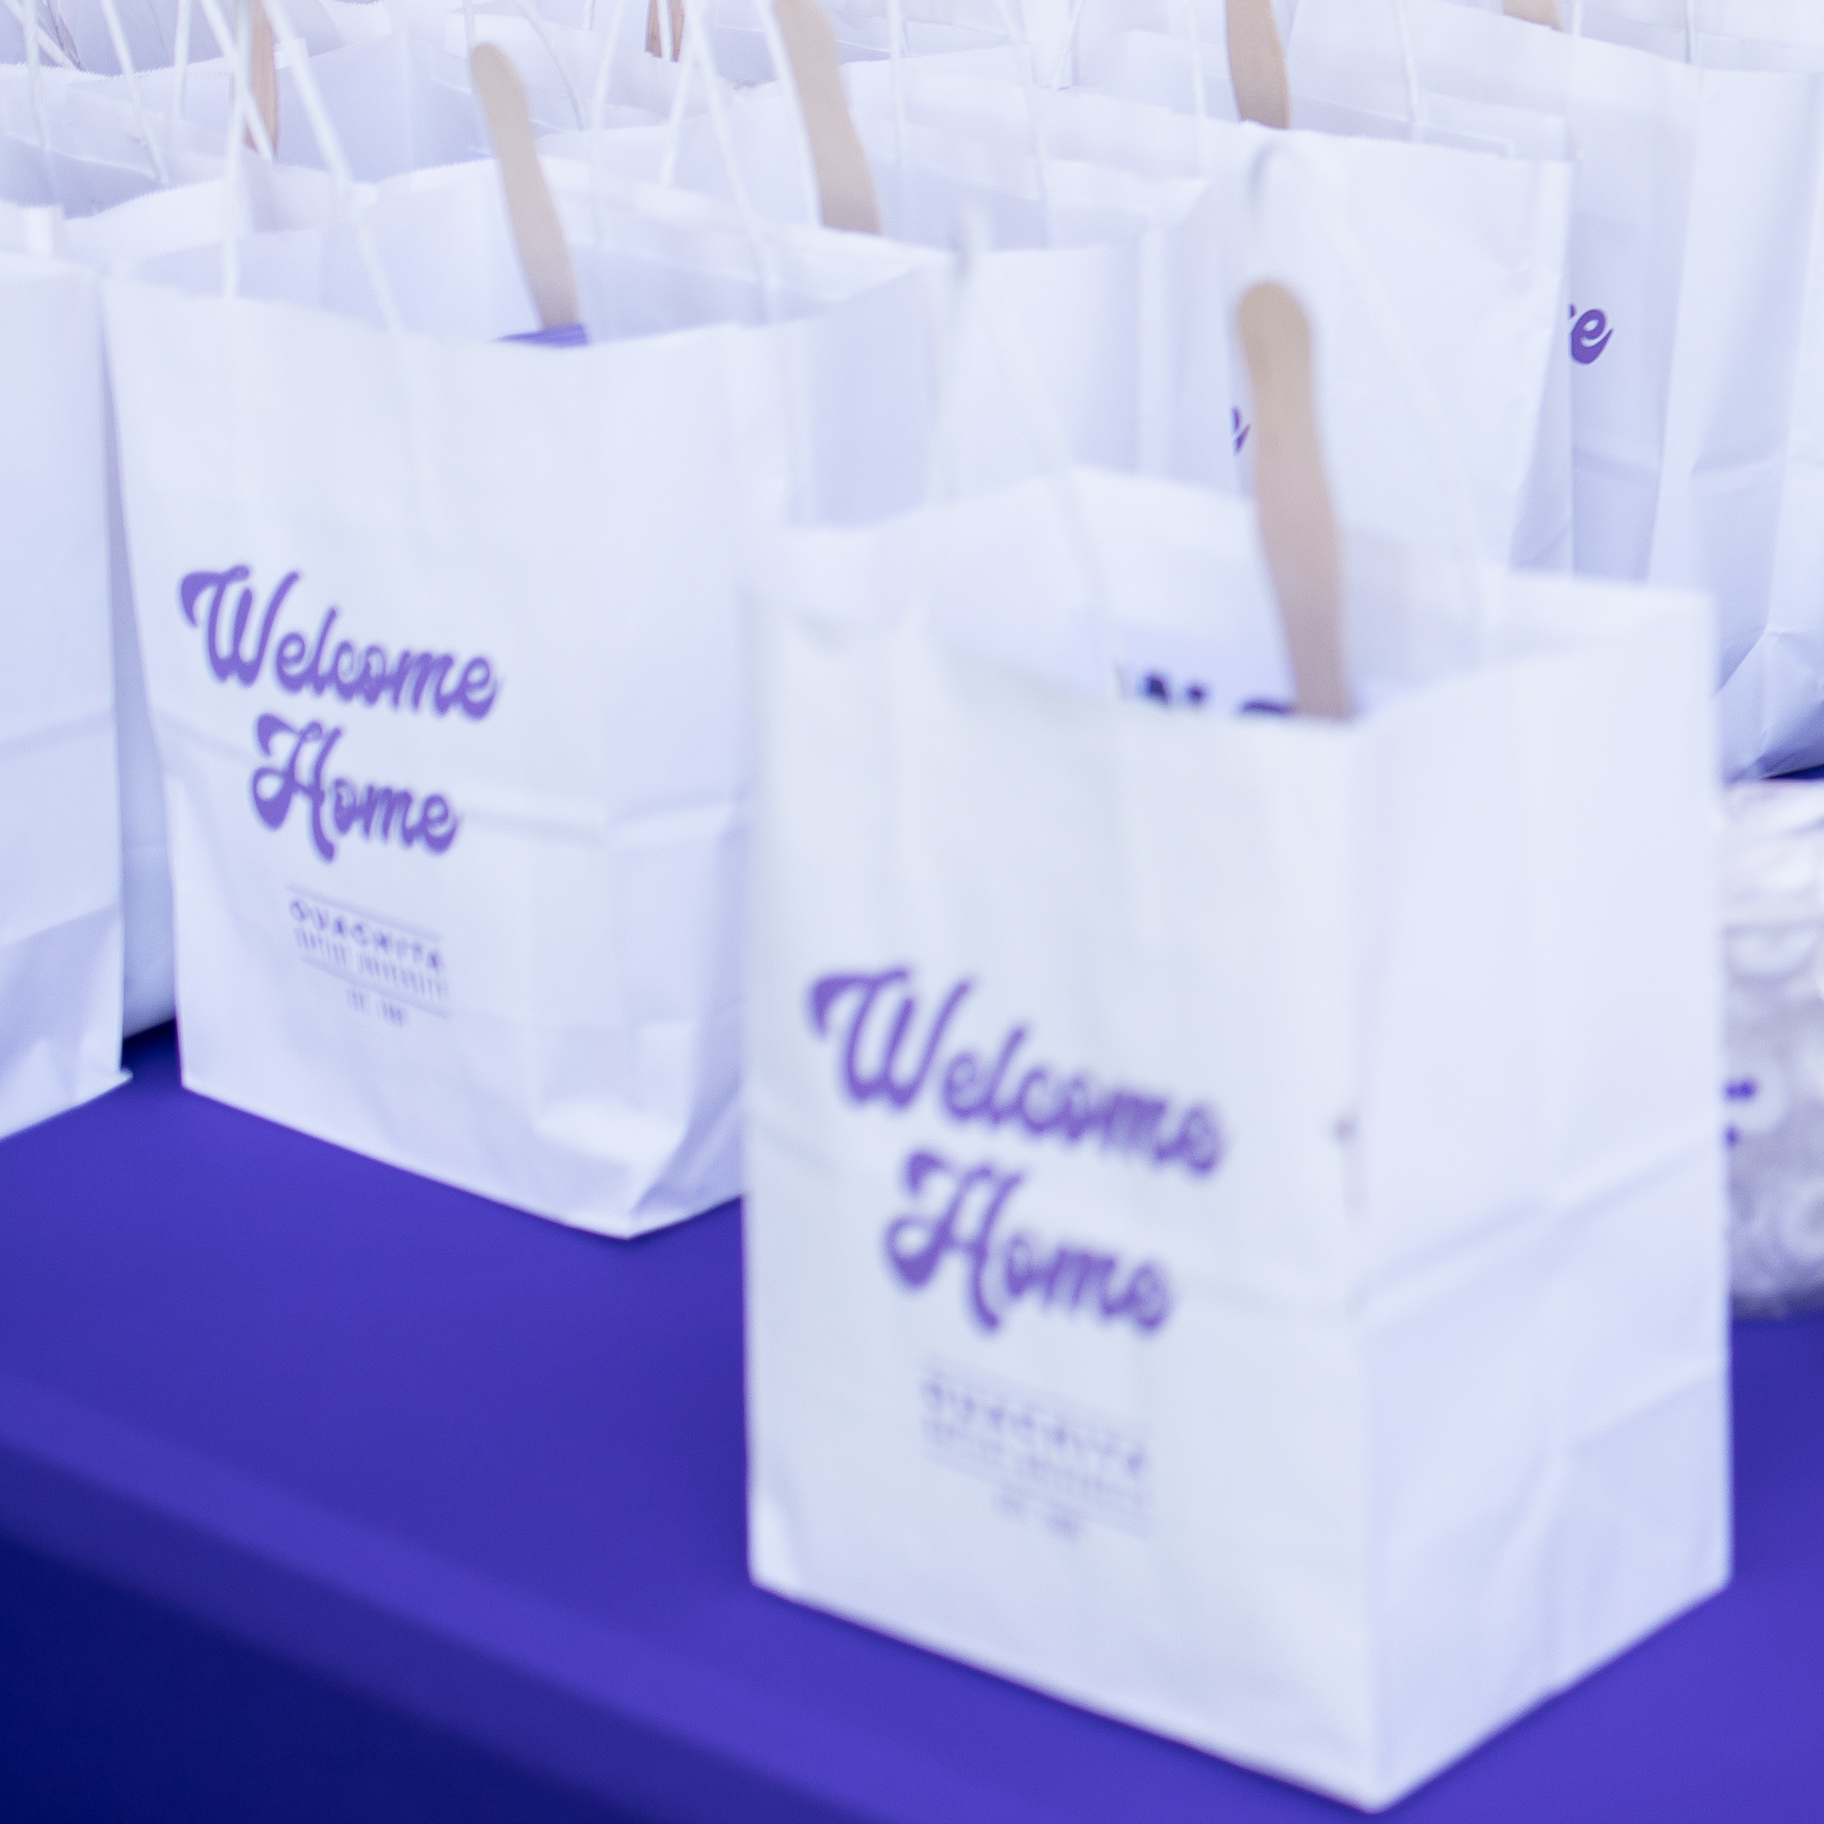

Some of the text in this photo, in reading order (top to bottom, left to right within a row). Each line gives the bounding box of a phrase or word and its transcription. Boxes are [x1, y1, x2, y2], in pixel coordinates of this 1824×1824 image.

[178, 562, 503, 722] Welcome
[250, 712, 463, 864] Home
[807, 964, 1227, 1176] Welcome
[882, 1147, 1177, 1335] Home
